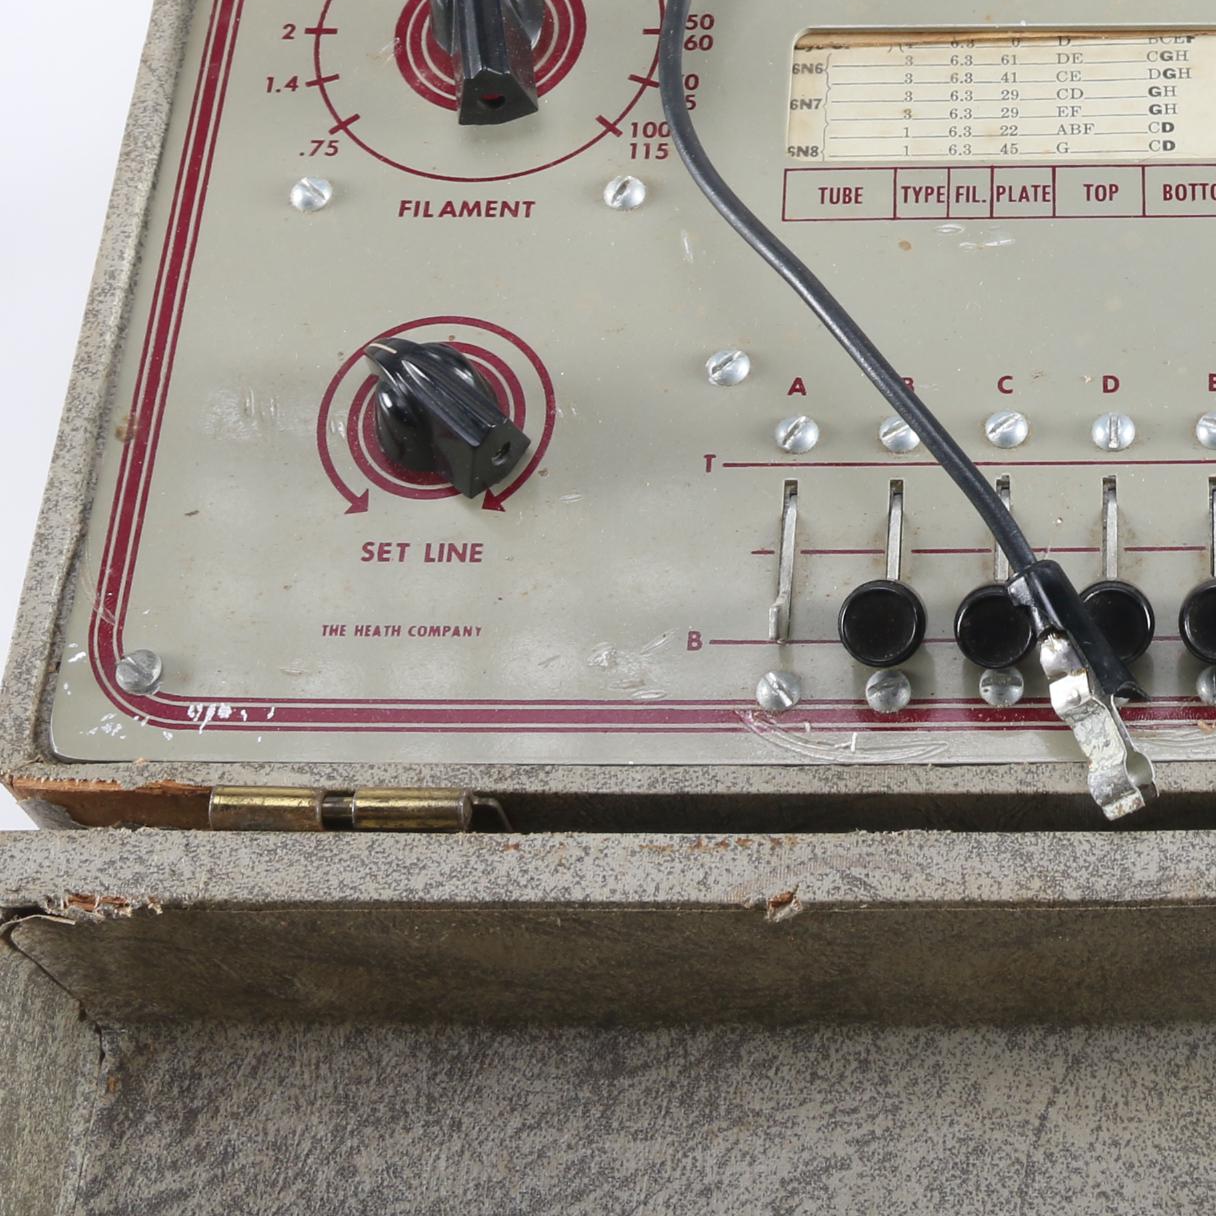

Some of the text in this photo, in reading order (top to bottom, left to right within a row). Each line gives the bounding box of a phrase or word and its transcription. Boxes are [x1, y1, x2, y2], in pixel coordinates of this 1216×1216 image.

[685, 13, 715, 31] 50
[282, 24, 295, 39] 2
[683, 34, 714, 52] 60
[904, 50, 1189, 66] 3 6.3 61 DE CGH
[792, 63, 823, 74] 6N6
[904, 68, 1191, 84] 3 6.3 41 CE DGH
[267, 76, 298, 92] 1.4
[904, 86, 1178, 102] 3 6.3 29 CD GH
[790, 99, 822, 111] 6N7
[903, 104, 1178, 119] 3 6.3 29 EF GH
[629, 122, 670, 139] 100
[904, 122, 1175, 138] 1 6.3 22 ABF CD
[300, 140, 338, 156] .75
[630, 143, 668, 159] 115
[904, 140, 1176, 156] 1 6.3 45 G CD
[819, 187, 863, 204] TUBE
[901, 186, 945, 203] TYPE
[956, 186, 986, 203] FIL.
[997, 185, 1050, 202] PLATE
[1084, 184, 1118, 201] TOP
[399, 200, 535, 217] FILAMENT
[788, 377, 806, 395] A
[998, 376, 1013, 394] C
[1103, 376, 1119, 393] D
[704, 455, 716, 472] T
[361, 542, 483, 562] SET LINE
[323, 625, 481, 636] THE HEATH COMPANY
[688, 632, 701, 650] B
